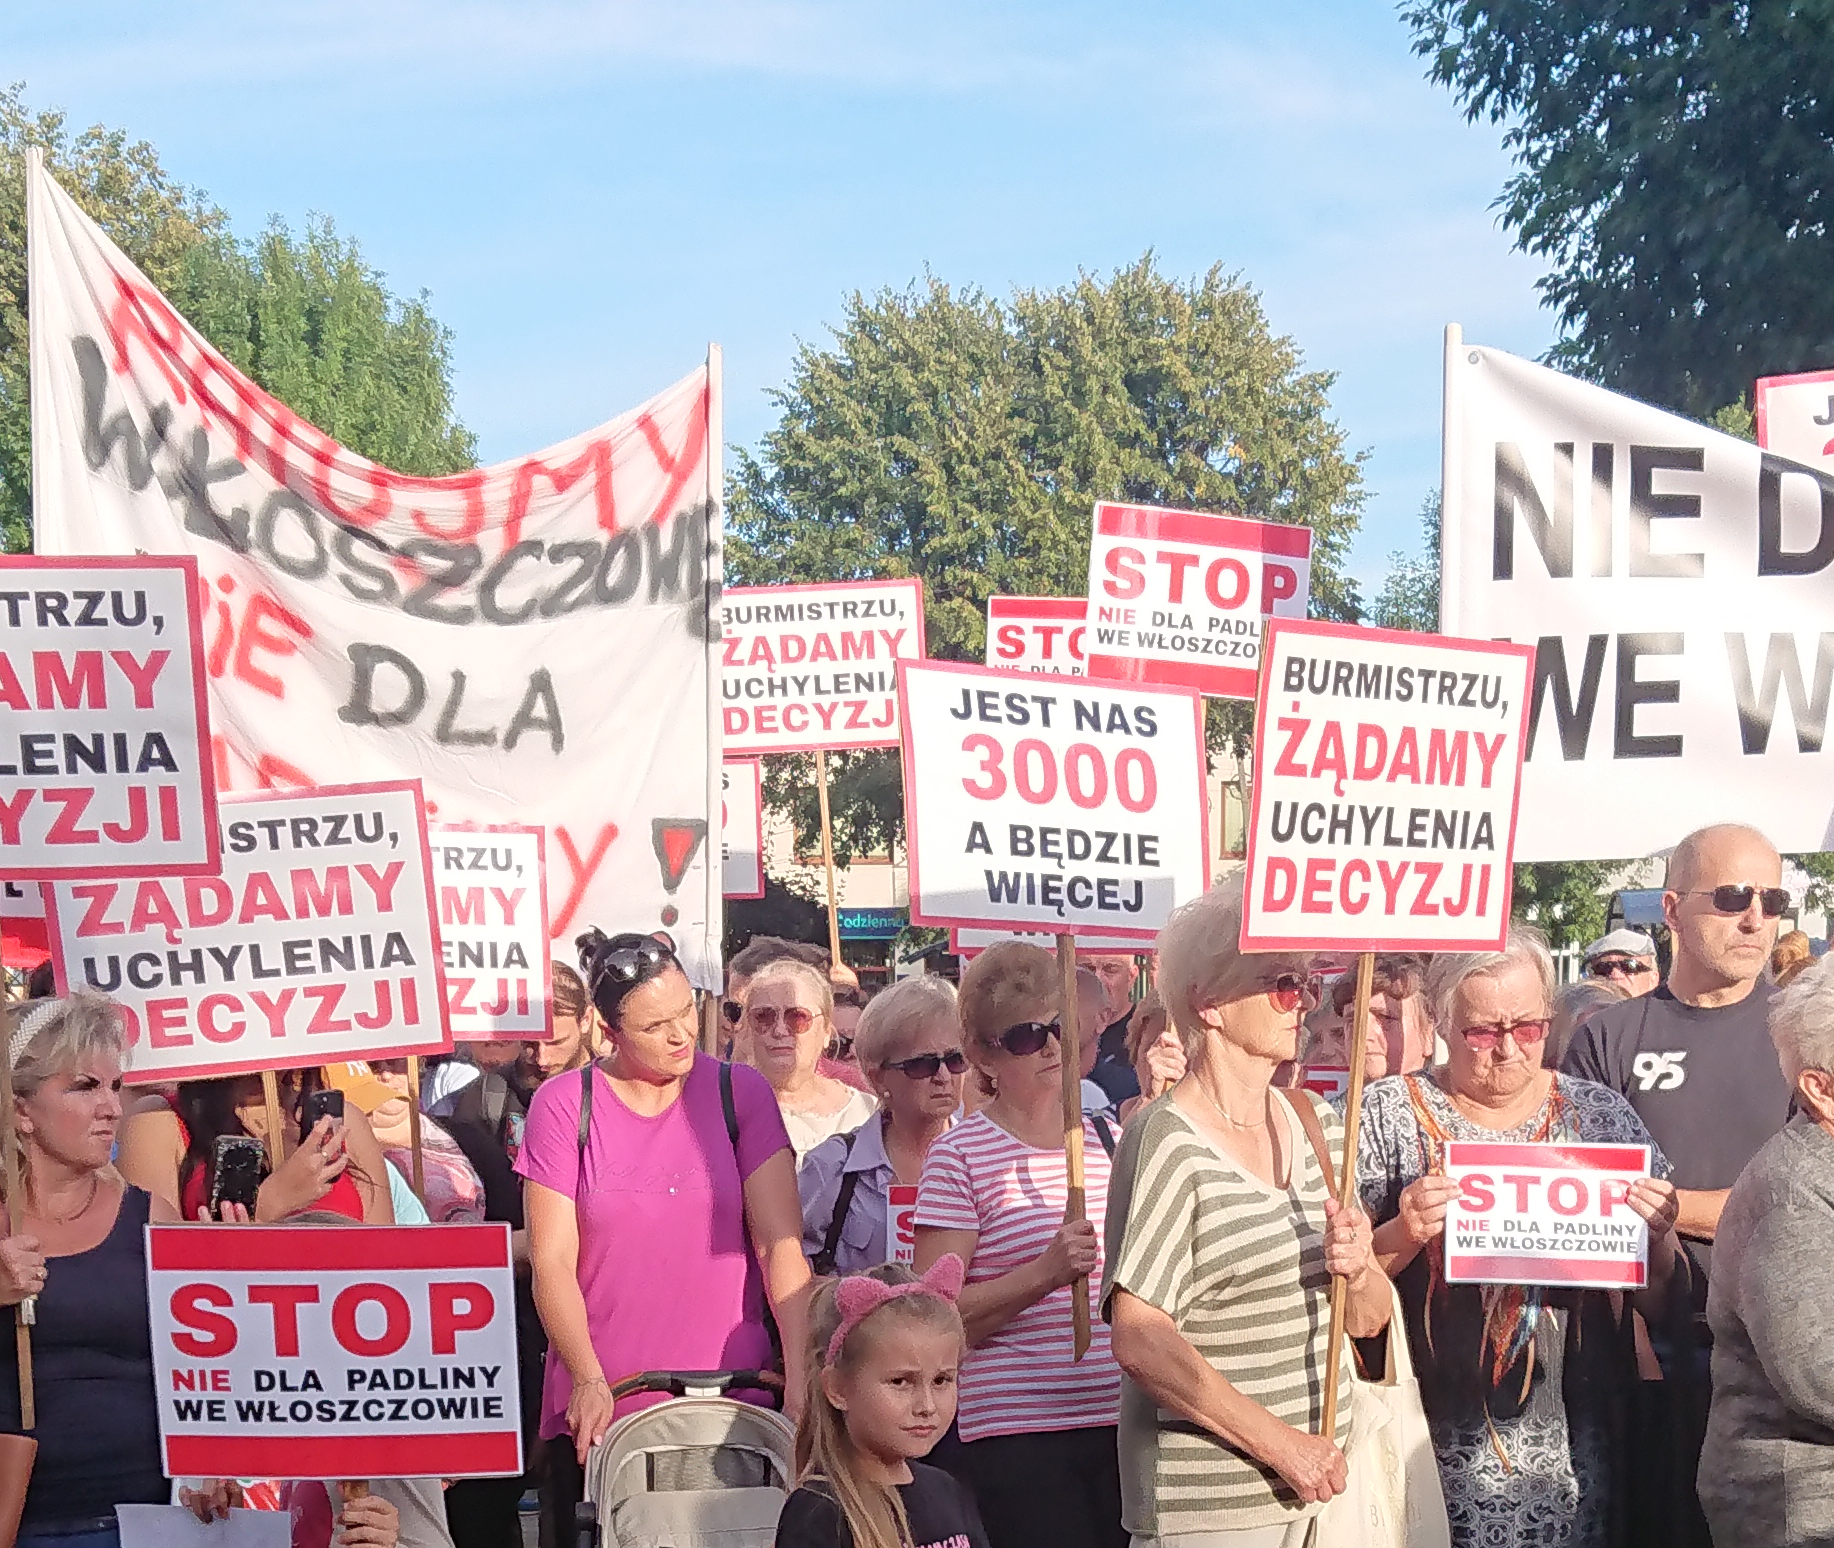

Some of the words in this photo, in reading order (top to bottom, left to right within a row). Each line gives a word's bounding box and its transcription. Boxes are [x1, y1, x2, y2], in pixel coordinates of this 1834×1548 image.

[1492, 441, 1706, 581] NIE
[1102, 545, 1299, 615] STOP
[995, 624, 1087, 661] STO
[1097, 627, 1130, 647] WE
[1137, 631, 1262, 660] WŁOSZCZO
[1098, 605, 1136, 624] NIE
[1152, 610, 1194, 631] DLA
[1207, 617, 1260, 638] PADL
[722, 627, 908, 673] ŻĄDAMY
[337, 641, 566, 755] DLA
[1282, 655, 1510, 720] BURMISTRZU,
[1489, 631, 1685, 761] WE
[723, 699, 895, 736] DECYZJ
[949, 687, 1057, 729] JEST
[1073, 698, 1159, 739] NAS
[960, 732, 1158, 814] 3000
[1273, 700, 1508, 798] ŻĄDAMY
[964, 820, 994, 856] A
[1008, 822, 1161, 870] BĘDZIE
[1270, 800, 1496, 852] UCHYLENIA
[985, 869, 1144, 918] WIĘCEJ
[1261, 855, 1492, 918] DECYZJI
[82, 931, 417, 993] UCHYLENIA
[1632, 1050, 1688, 1091] 95
[1457, 1172, 1633, 1218] STOP
[1455, 1235, 1487, 1248] WE
[1491, 1235, 1638, 1254] WŁOSZCZOWIE
[1456, 1218, 1491, 1232] NIE
[1503, 1219, 1541, 1234] DLA
[1553, 1221, 1638, 1238] PADLINY
[169, 1281, 496, 1359] STOP
[171, 1368, 233, 1393] NIE
[253, 1368, 325, 1393] DLA
[346, 1365, 503, 1392] PADLINY
[172, 1399, 227, 1423] WE
[235, 1395, 505, 1423] WŁOSZCZOWIE
